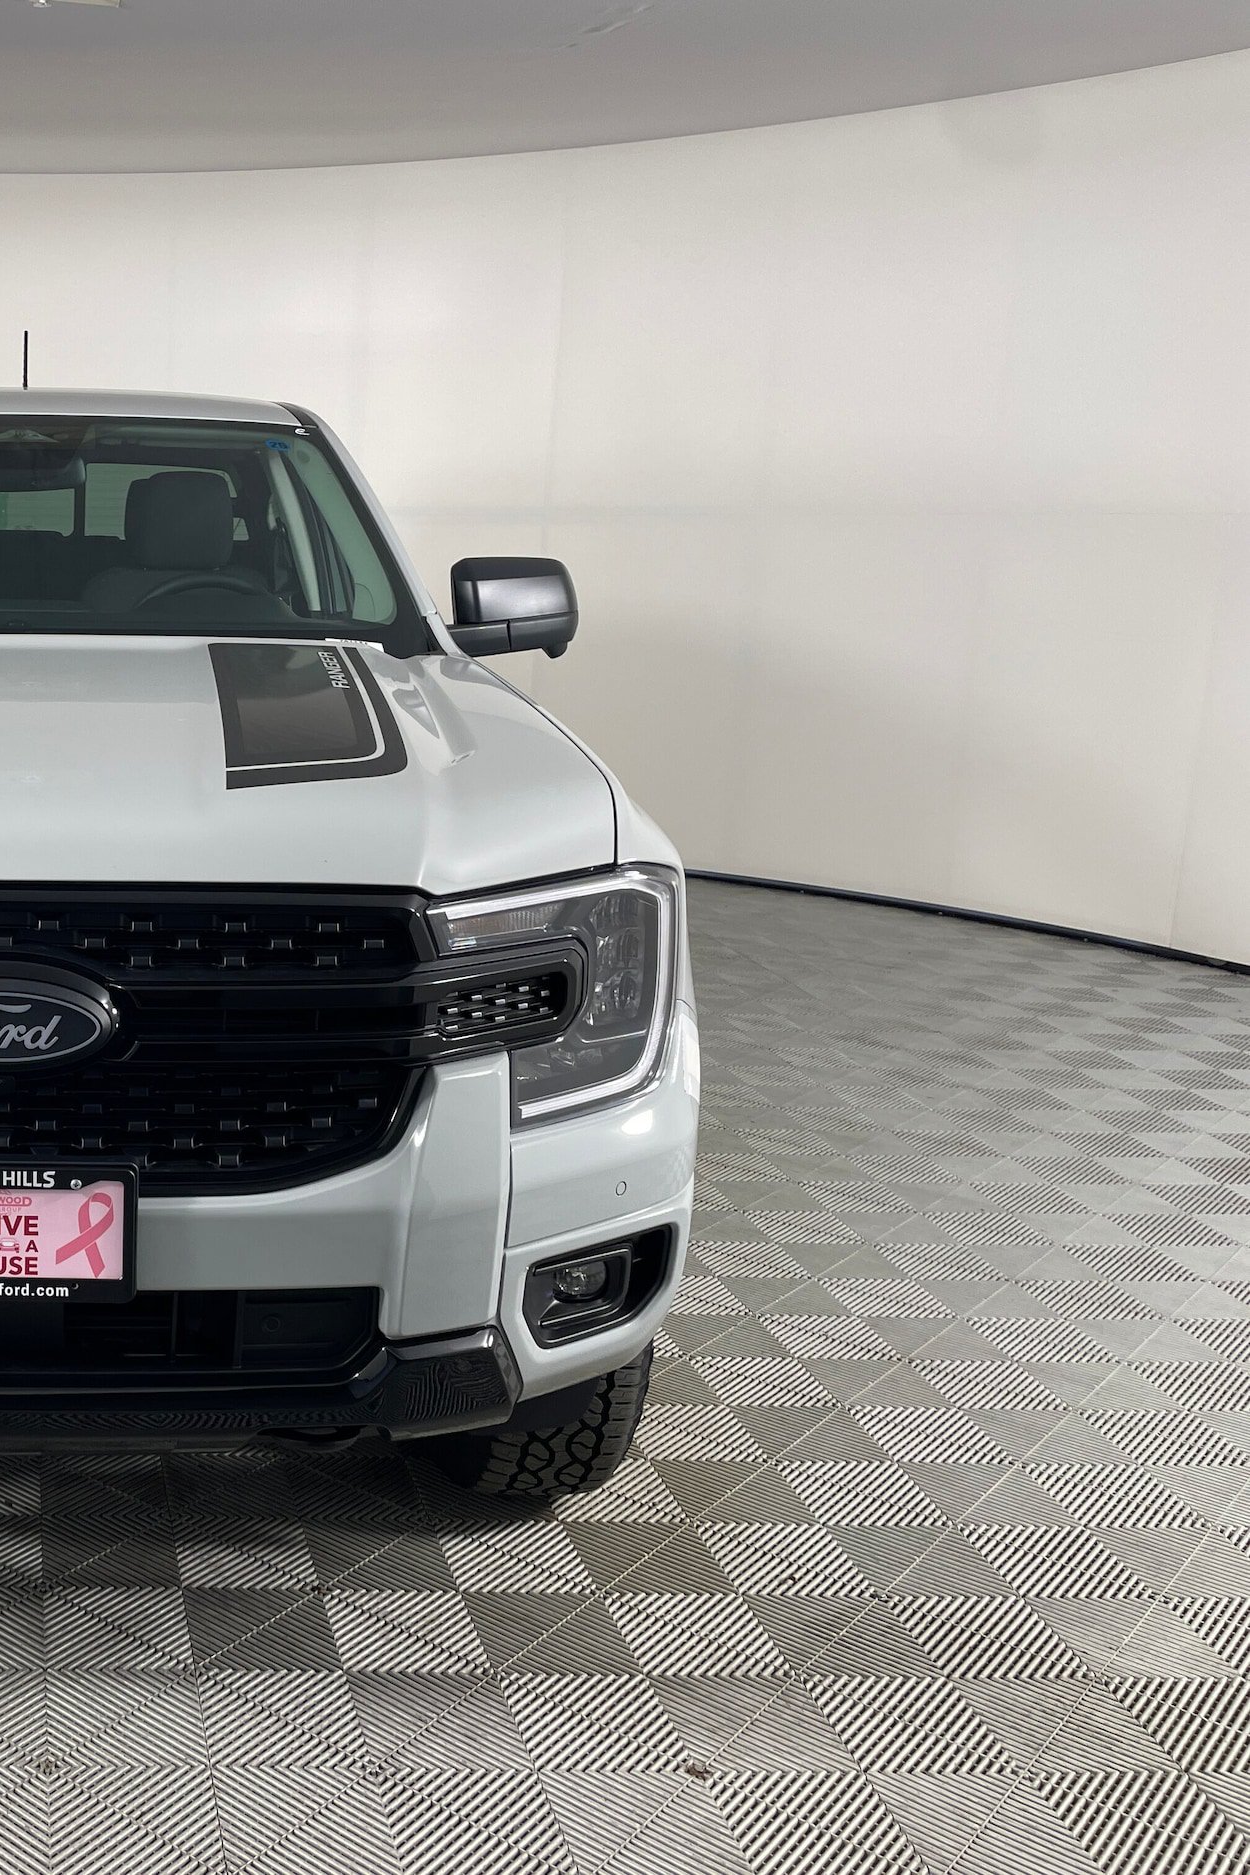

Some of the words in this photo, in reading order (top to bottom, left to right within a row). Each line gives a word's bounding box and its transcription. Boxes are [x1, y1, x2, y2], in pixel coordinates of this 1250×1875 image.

[318, 651, 350, 689] RANGER
[3, 1170, 56, 1188] HILLS
[25, 1240, 39, 1252] A
